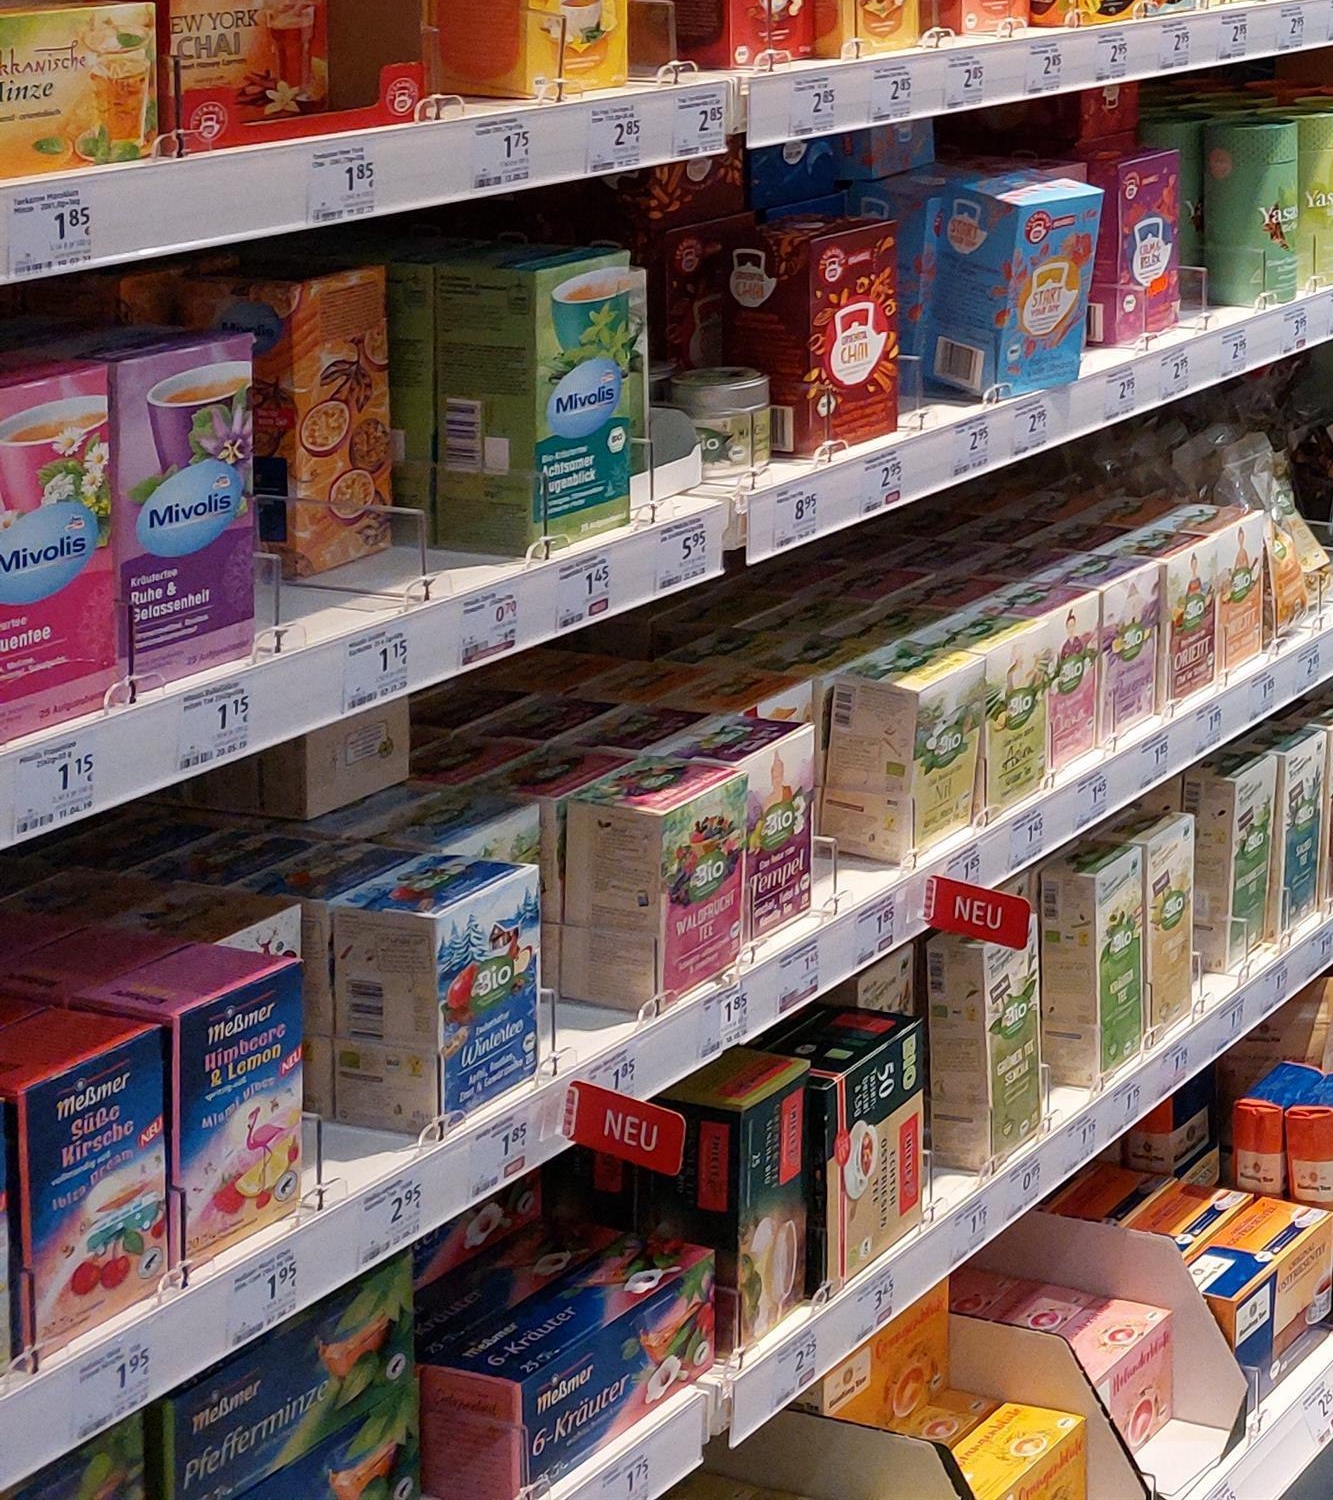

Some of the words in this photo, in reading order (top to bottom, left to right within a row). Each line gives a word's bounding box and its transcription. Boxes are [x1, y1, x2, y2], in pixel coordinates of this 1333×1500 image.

[170, 15, 203, 35] EW
[204, 8, 260, 30] YORK
[176, 31, 242, 62] CHAI
[554, 387, 615, 415] Mivolis
[149, 493, 232, 530] Mivolis
[0, 533, 87, 575] Mivolis
[131, 587, 163, 606] Ruhe
[0, 625, 52, 653] uentee
[749, 857, 806, 895] Tempel
[675, 892, 735, 937] WALDFRUCHT
[953, 897, 1003, 931] NEU
[477, 965, 511, 995] Bio
[207, 1001, 276, 1045] Meßmer
[204, 1022, 287, 1072] Himbeere
[227, 1043, 282, 1081] Lemon
[56, 1070, 131, 1121] Meßmer
[61, 1118, 135, 1165] Kirsche
[71, 1101, 121, 1144] Süße
[603, 1108, 659, 1152] NEU
[487, 1304, 578, 1368] 6-Kräuter
[535, 1361, 595, 1414] Meßmer
[182, 1376, 331, 1490] Pfefferminze
[531, 1372, 631, 1458] 6-Kräuter
